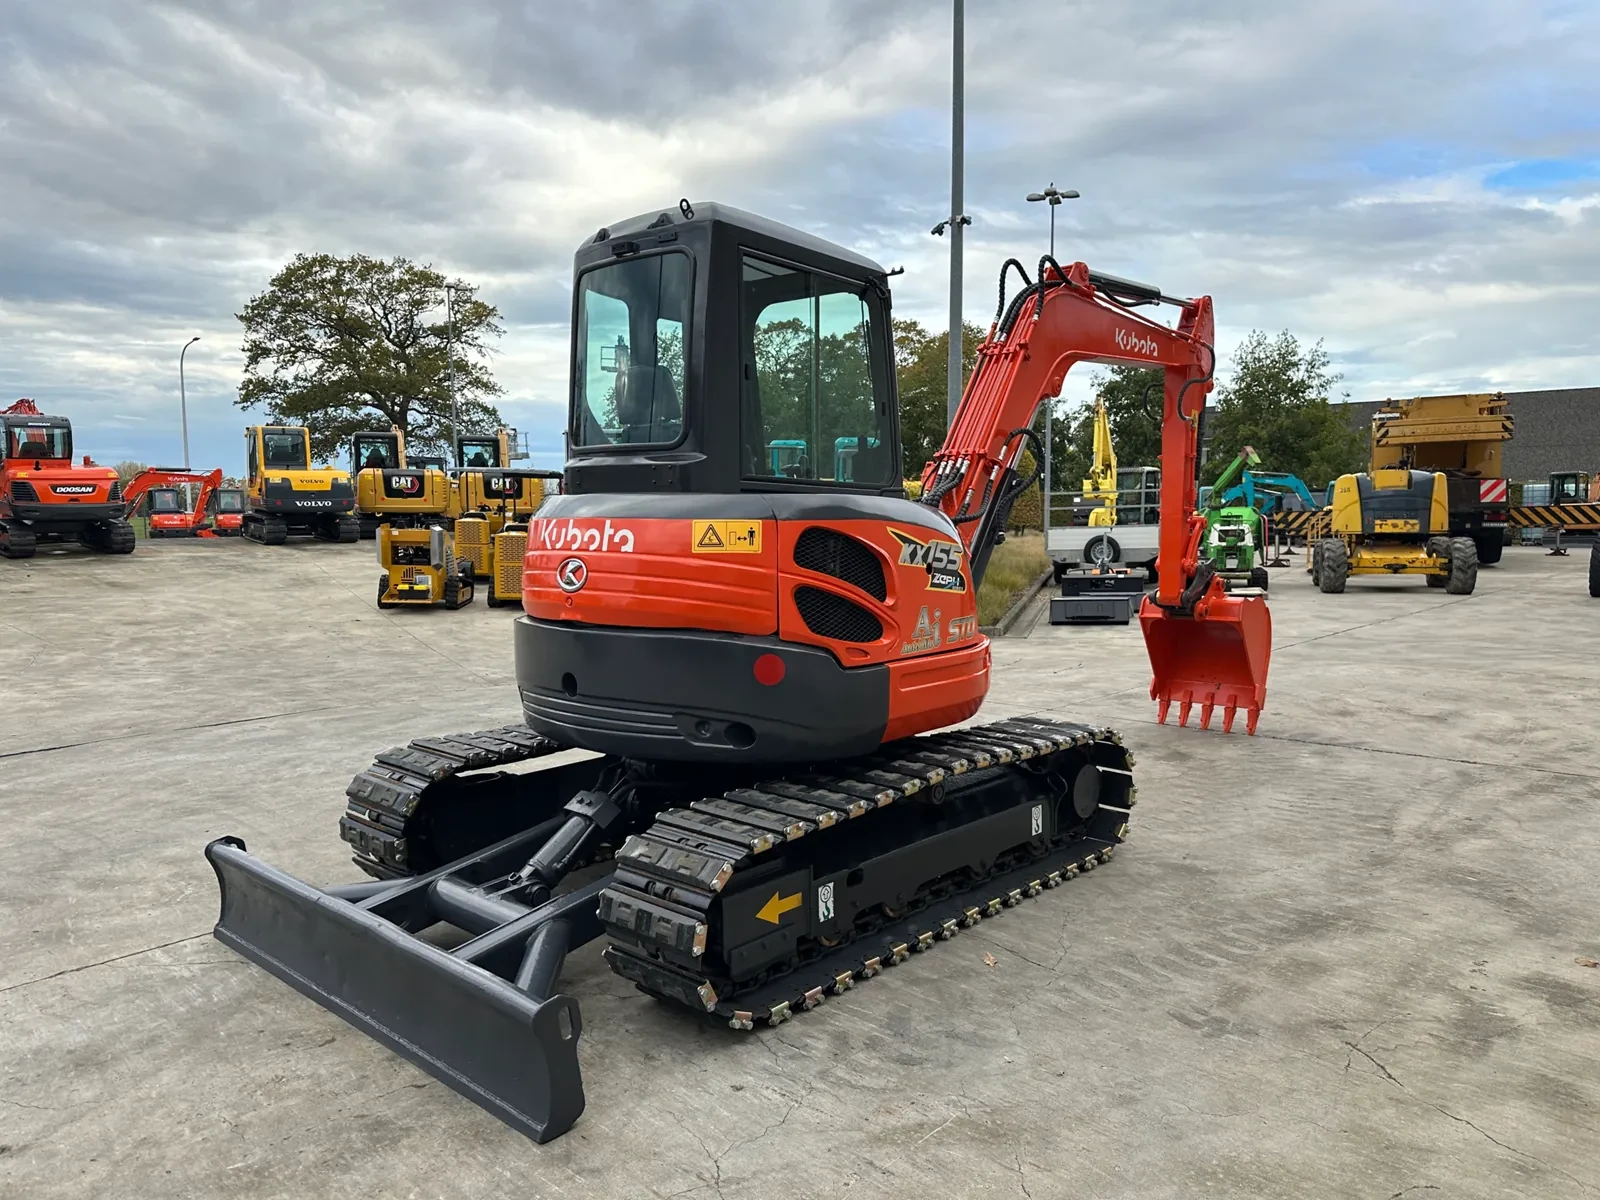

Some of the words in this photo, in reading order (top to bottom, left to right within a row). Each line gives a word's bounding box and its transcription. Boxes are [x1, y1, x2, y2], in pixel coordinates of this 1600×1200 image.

[1115, 327, 1158, 357] Kubota
[391, 476, 412, 488] CAT
[541, 518, 635, 553] Kubota
[899, 541, 963, 571] KX155
[946, 615, 976, 644] STD
